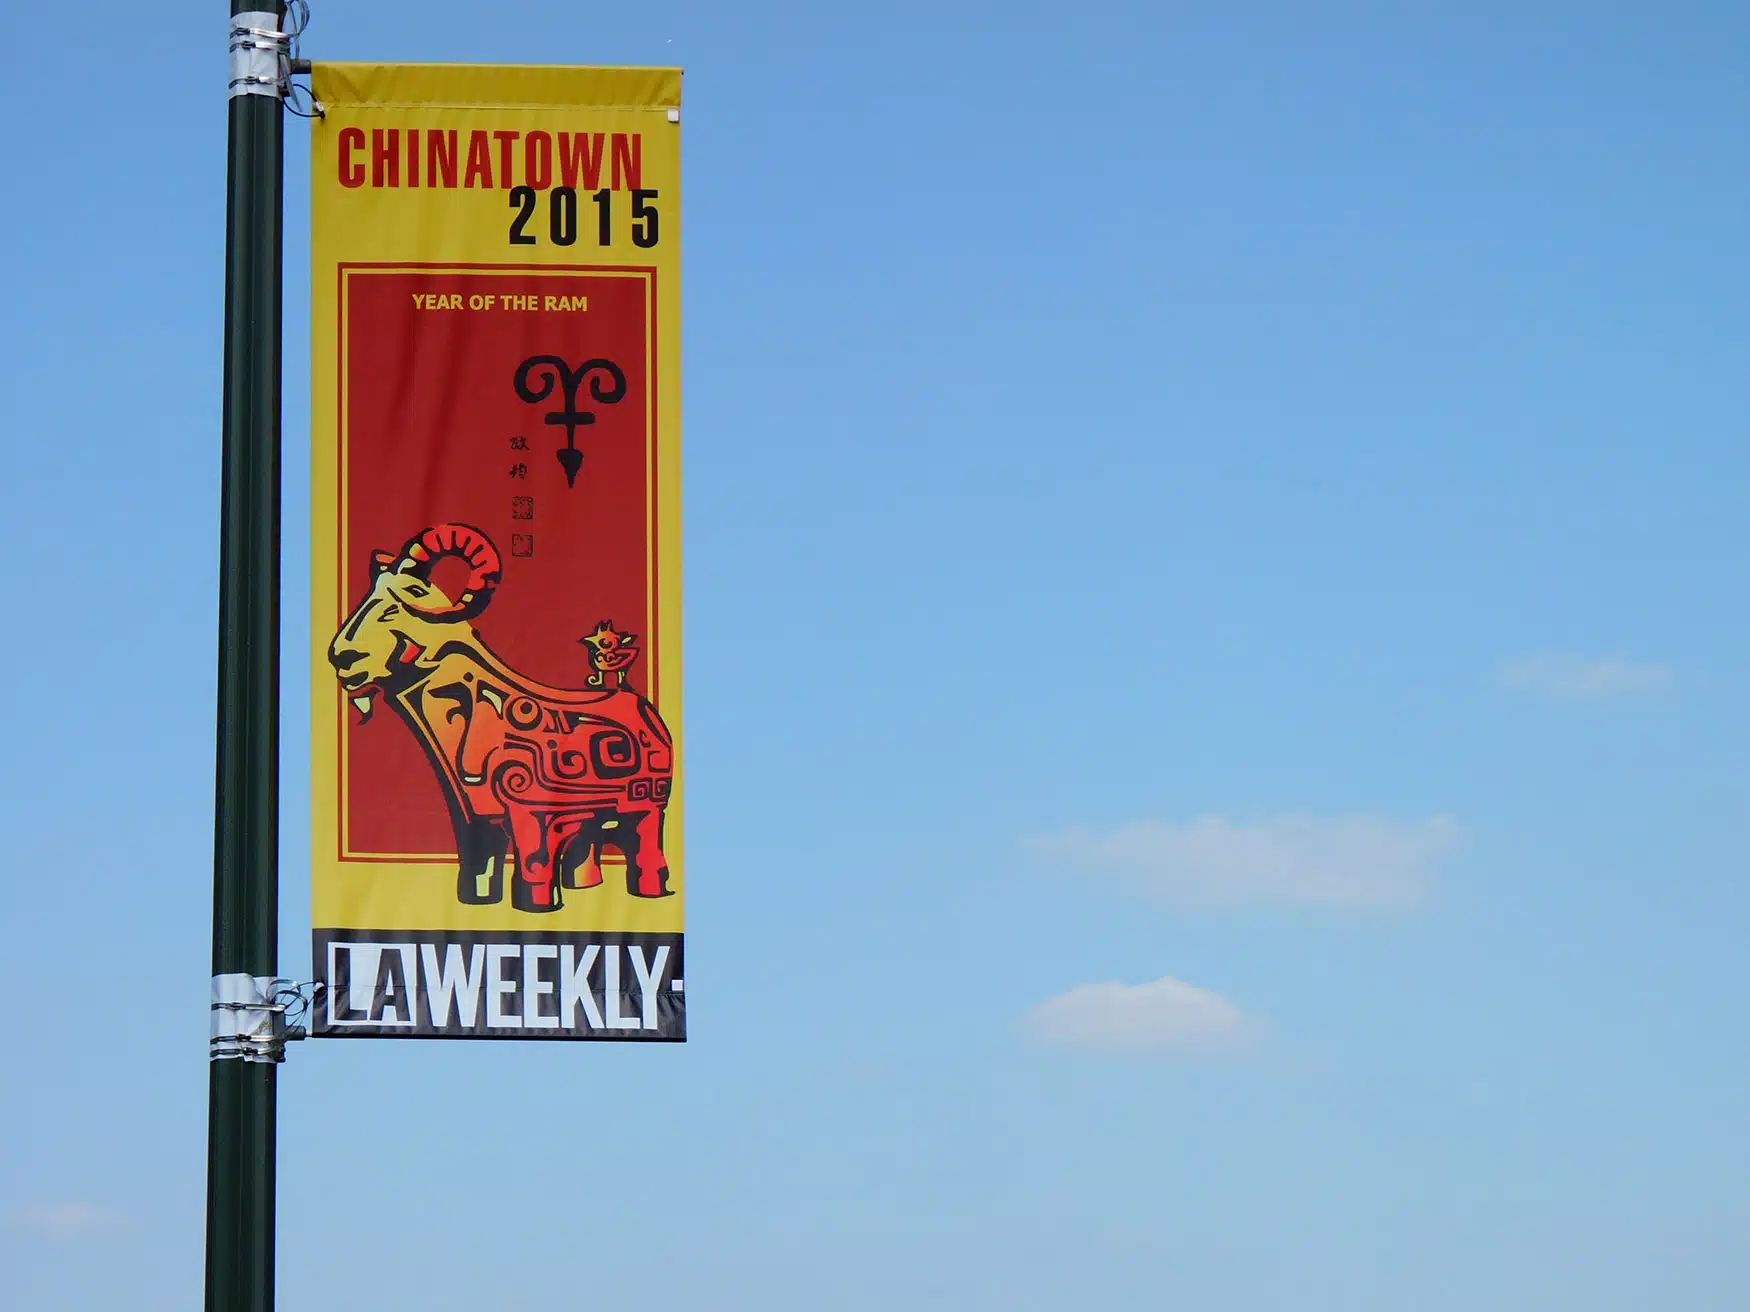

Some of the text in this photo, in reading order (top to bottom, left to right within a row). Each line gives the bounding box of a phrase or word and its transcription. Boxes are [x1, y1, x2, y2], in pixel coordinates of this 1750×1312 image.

[337, 127, 642, 192] CHINATOWN
[509, 186, 660, 248] 2015
[412, 294, 588, 312] YEAR OF THE RAM
